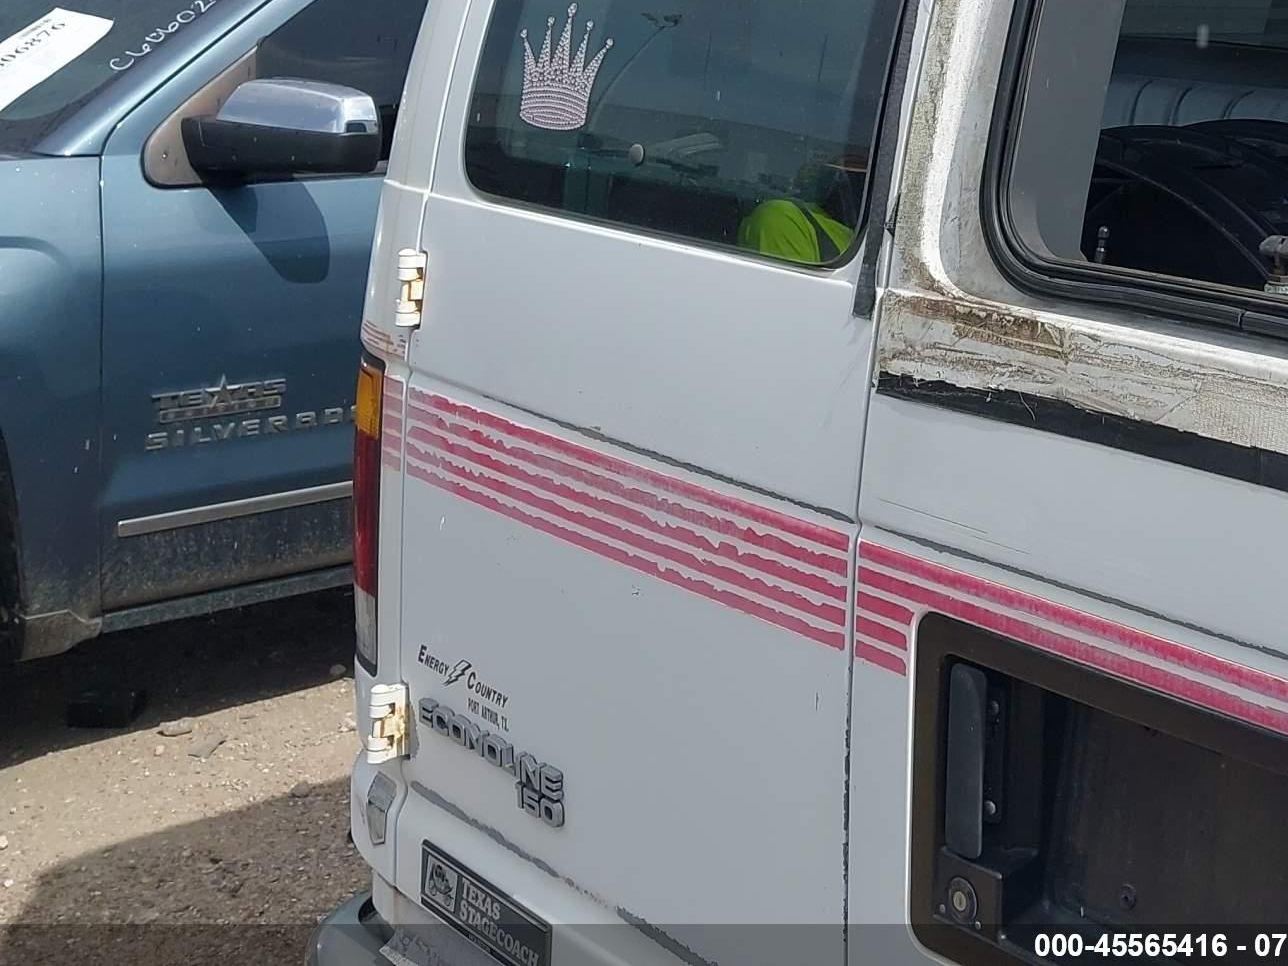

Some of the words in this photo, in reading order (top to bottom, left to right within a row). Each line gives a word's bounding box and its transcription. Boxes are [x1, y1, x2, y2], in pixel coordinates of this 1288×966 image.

[418, 697, 564, 802] ECONOLINE
[514, 778, 565, 828] 150
[461, 876, 501, 920] TEXAS
[459, 898, 540, 966] STAGECOACH
